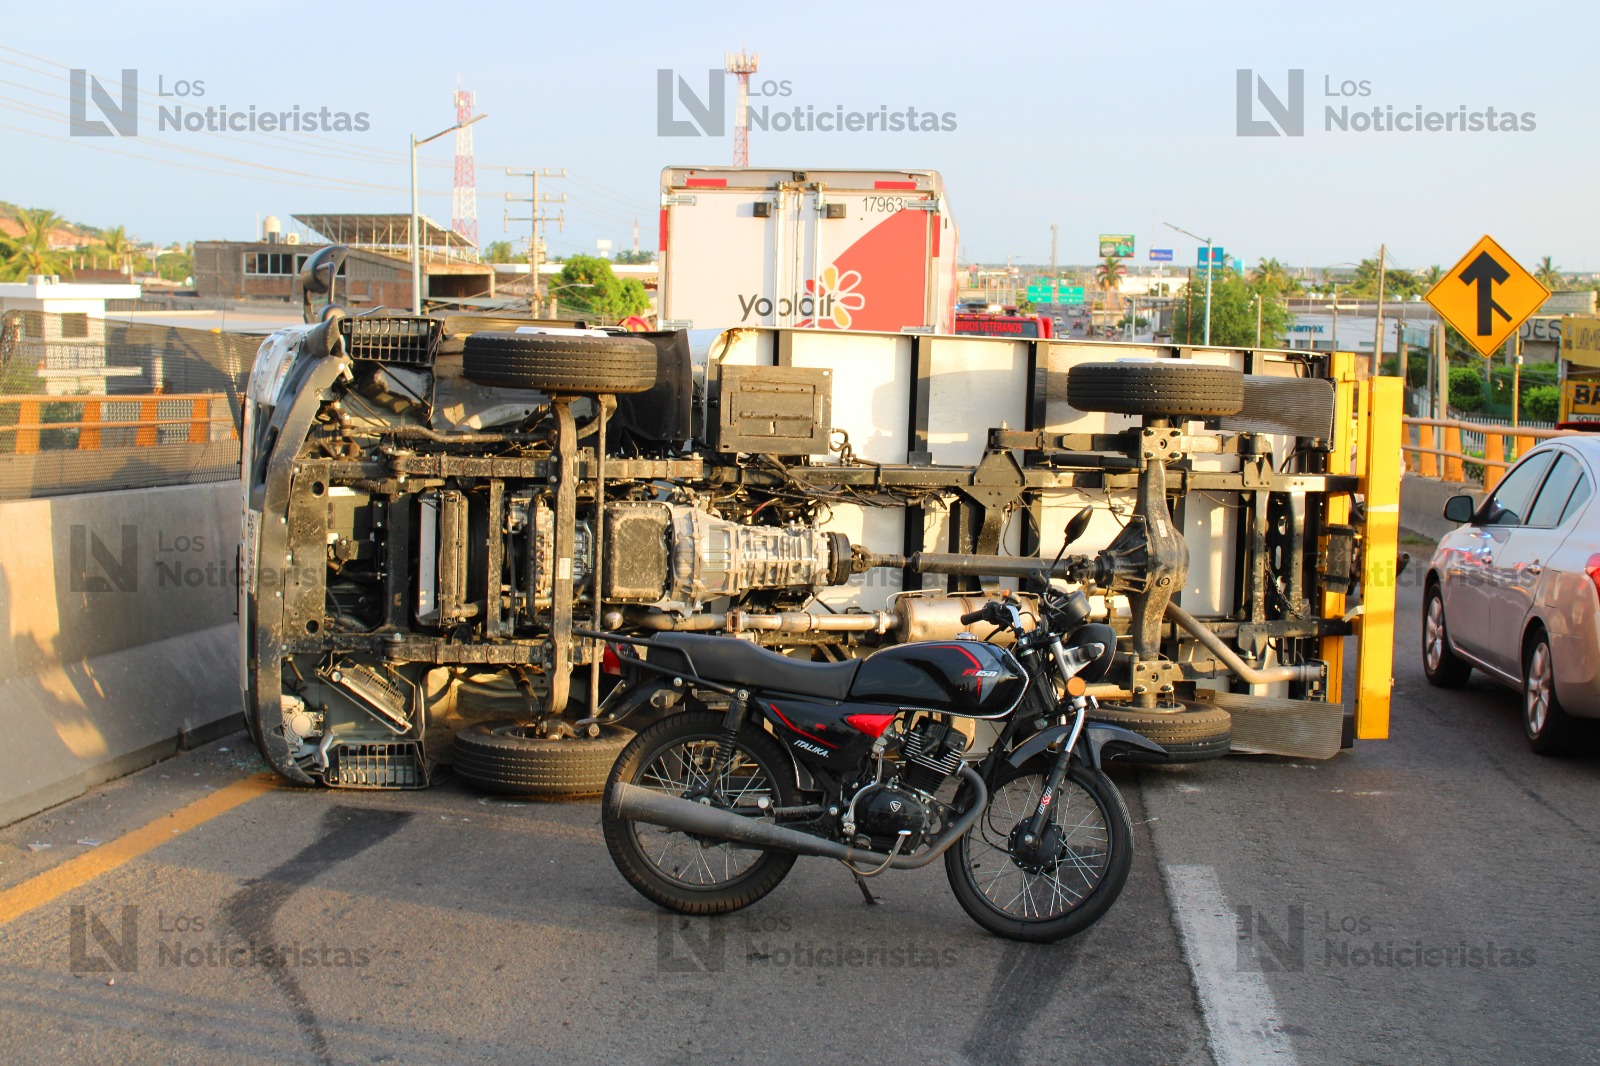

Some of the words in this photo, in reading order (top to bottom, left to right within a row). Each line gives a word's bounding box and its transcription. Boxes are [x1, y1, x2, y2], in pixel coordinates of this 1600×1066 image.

[863, 196, 903, 213] 17963
[738, 292, 836, 322] Yoplait
[980, 321, 1022, 334] VETERANOS
[793, 739, 829, 758] ITALIKA
